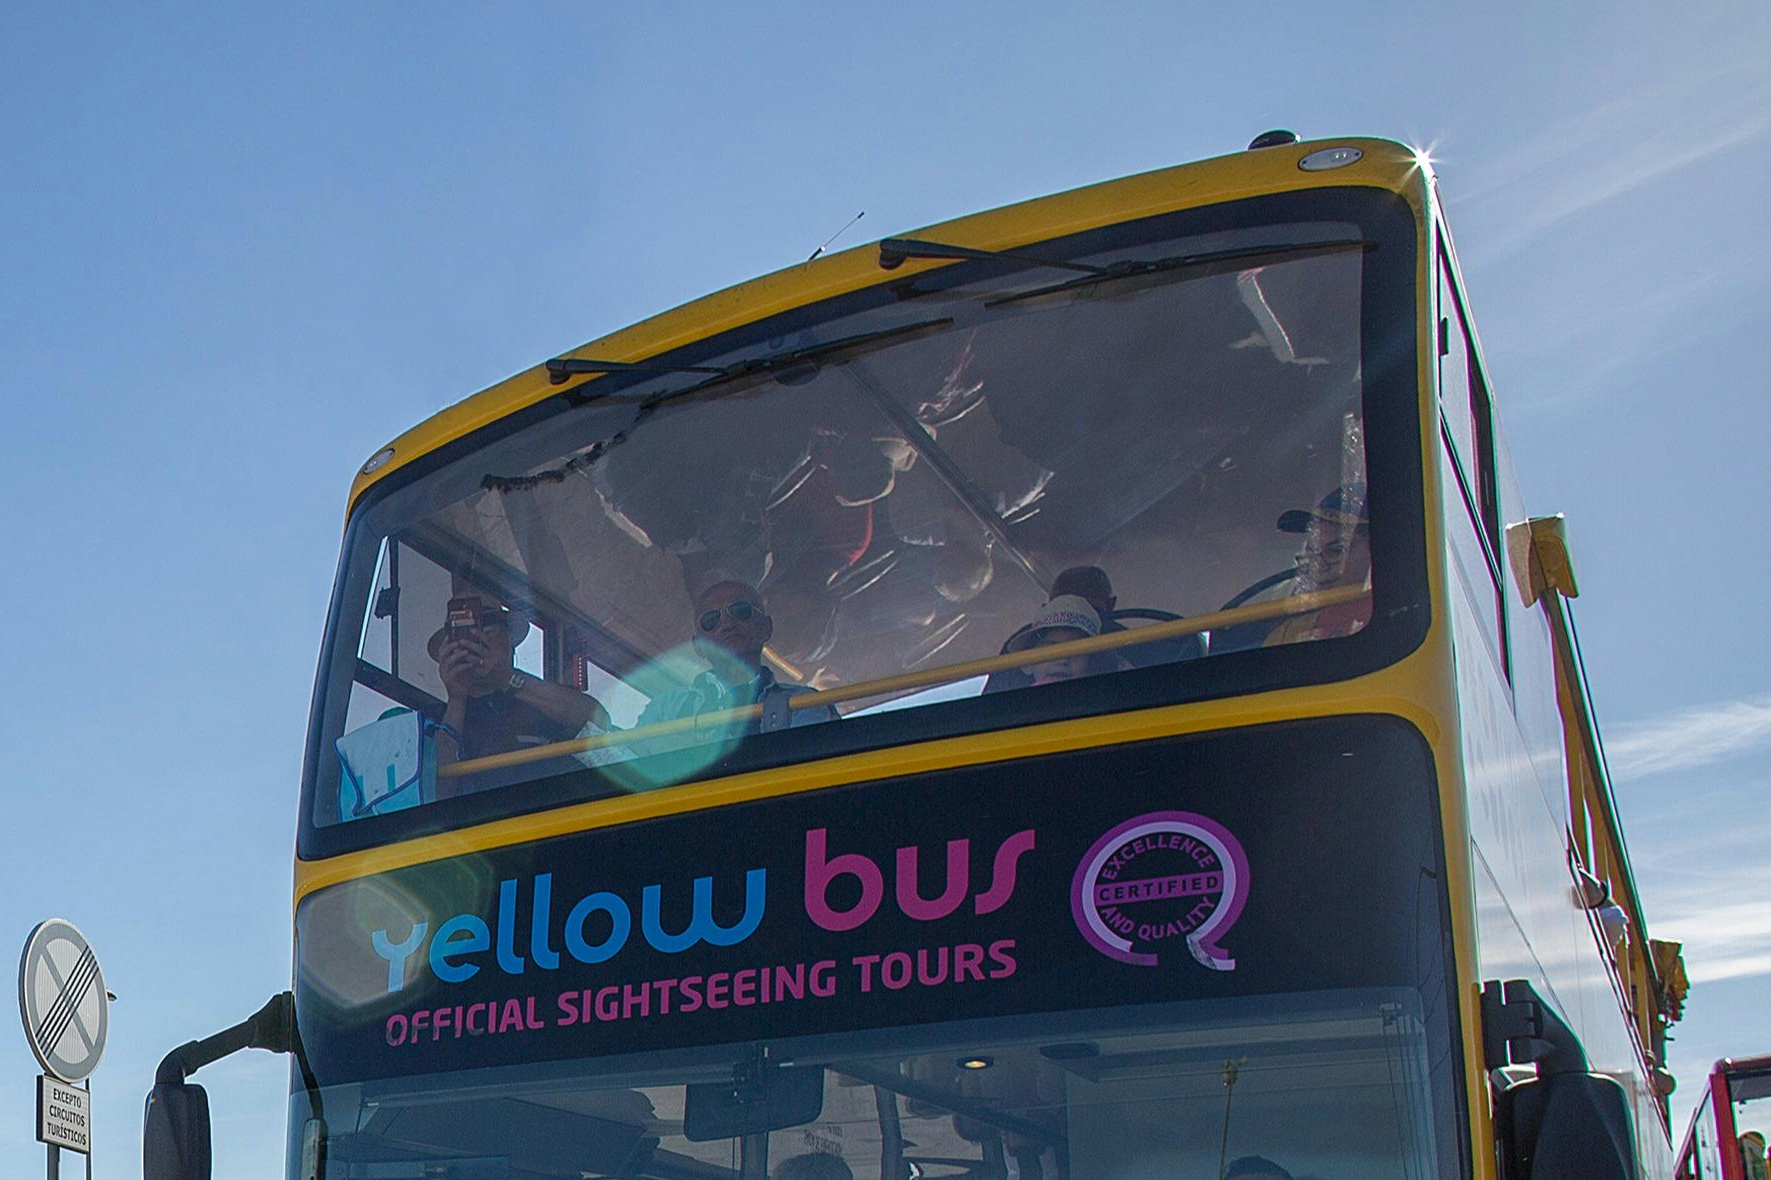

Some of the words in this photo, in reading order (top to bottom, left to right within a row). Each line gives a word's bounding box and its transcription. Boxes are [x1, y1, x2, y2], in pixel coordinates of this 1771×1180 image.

[1102, 834, 1215, 880] EXCELLENCE
[1099, 876, 1218, 901] CERTIFIED
[371, 866, 767, 993] yellow
[804, 828, 1036, 931] bus
[1101, 906, 1134, 934] AND
[1138, 896, 1215, 941] QUALITY
[385, 997, 545, 1047] OFFICIAL
[557, 960, 836, 1027] SIGHTSEEING
[852, 939, 1018, 993] TOURS
[53, 1088, 82, 1108] EXCEPTO
[49, 1105, 85, 1127] CIRCUITOS
[47, 1122, 87, 1146] TURÍSTICOS
